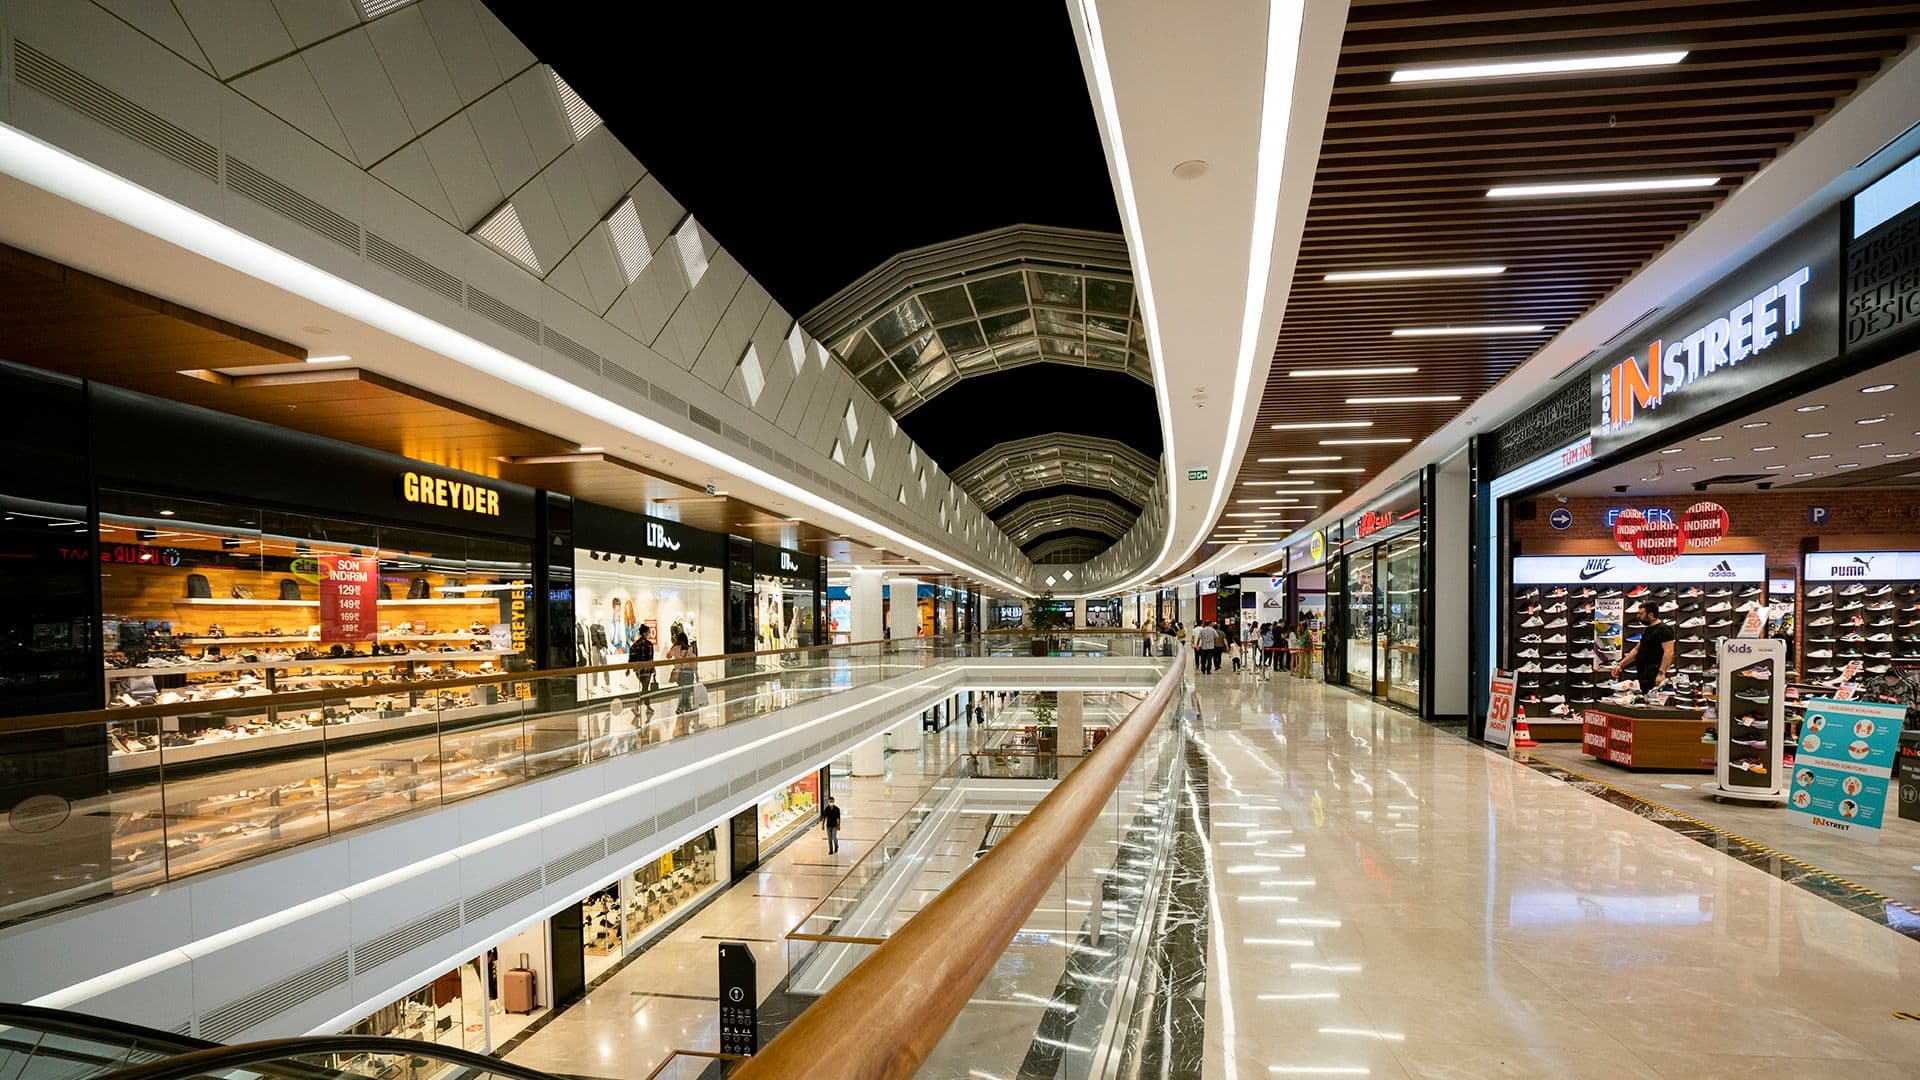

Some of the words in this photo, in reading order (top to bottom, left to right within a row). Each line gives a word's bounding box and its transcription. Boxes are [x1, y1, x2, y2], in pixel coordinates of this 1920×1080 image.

[1602, 373, 1611, 436] SPORT
[1561, 447, 1578, 467] TÜM
[404, 472, 500, 516] GREYDER
[647, 522, 664, 548] LTB
[338, 560, 359, 571] SON
[1585, 558, 1611, 570] NIKE
[1831, 566, 1865, 576] PUMA
[338, 584, 354, 596] 129
[339, 599, 354, 609] 149
[512, 580, 526, 652] GREYDER
[1746, 619, 1761, 628] 50
[1728, 644, 1752, 653] Kids
[1491, 697, 1510, 721] 50
[720, 948, 726, 957] 1
